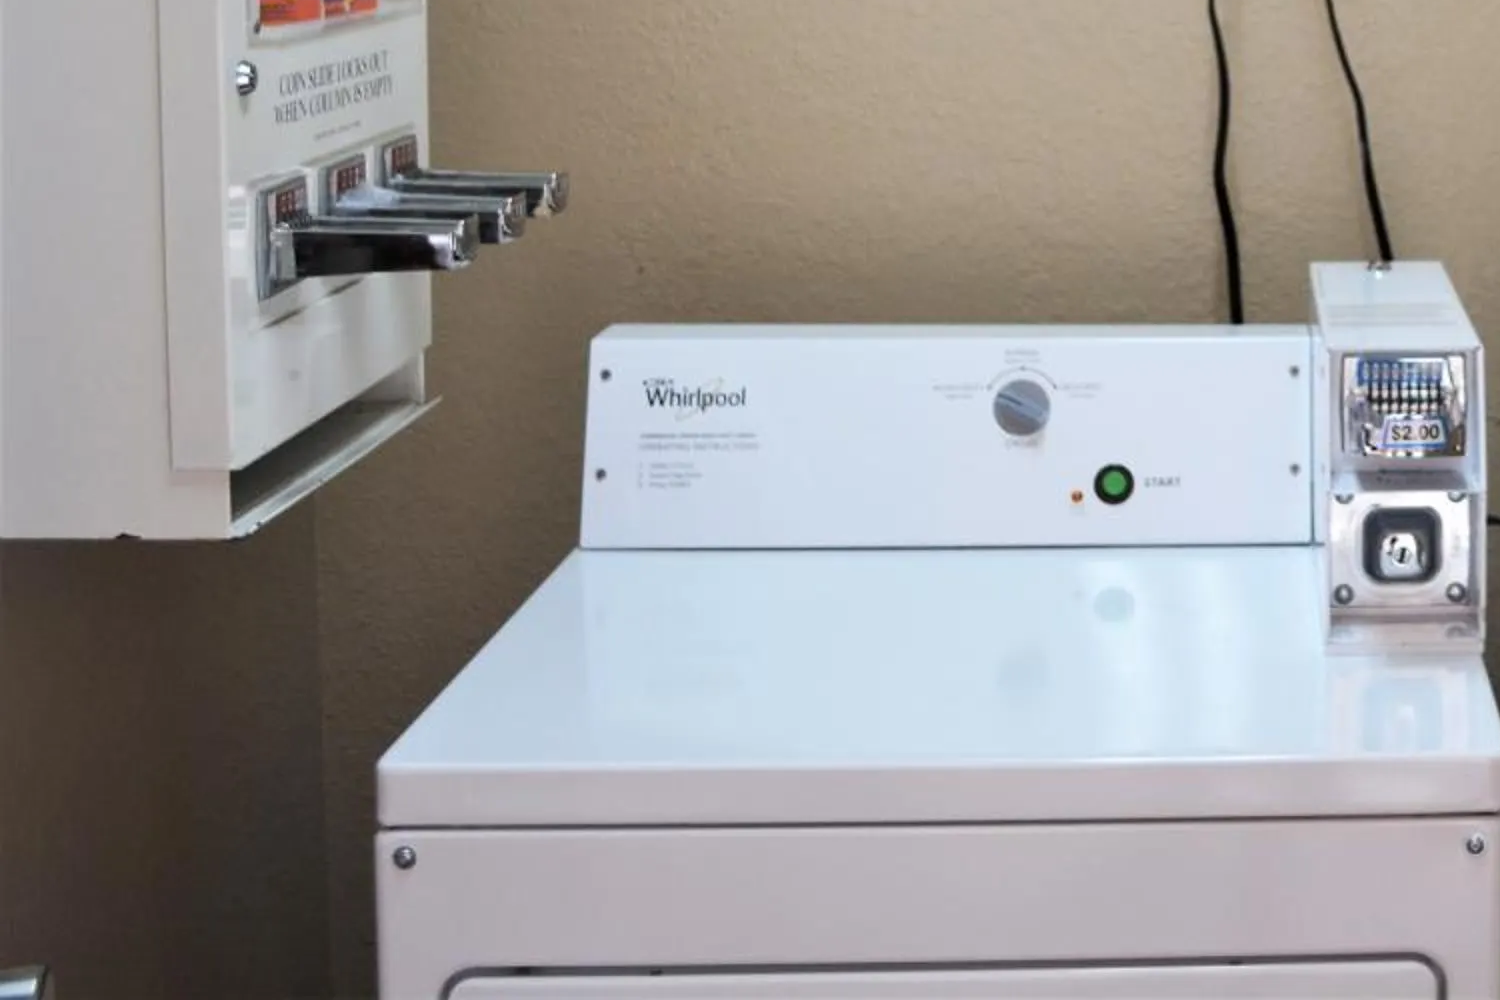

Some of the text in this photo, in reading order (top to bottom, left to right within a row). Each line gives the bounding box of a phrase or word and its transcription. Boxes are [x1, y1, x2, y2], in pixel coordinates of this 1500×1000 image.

[278, 50, 389, 97] COIN SLIDE LOCKS OUT
[273, 99, 308, 124] WHEN
[363, 74, 394, 100] EMPTY
[645, 385, 747, 414] Whirlpool
[1391, 423, 1440, 441] $2.00
[1143, 477, 1181, 488] START
